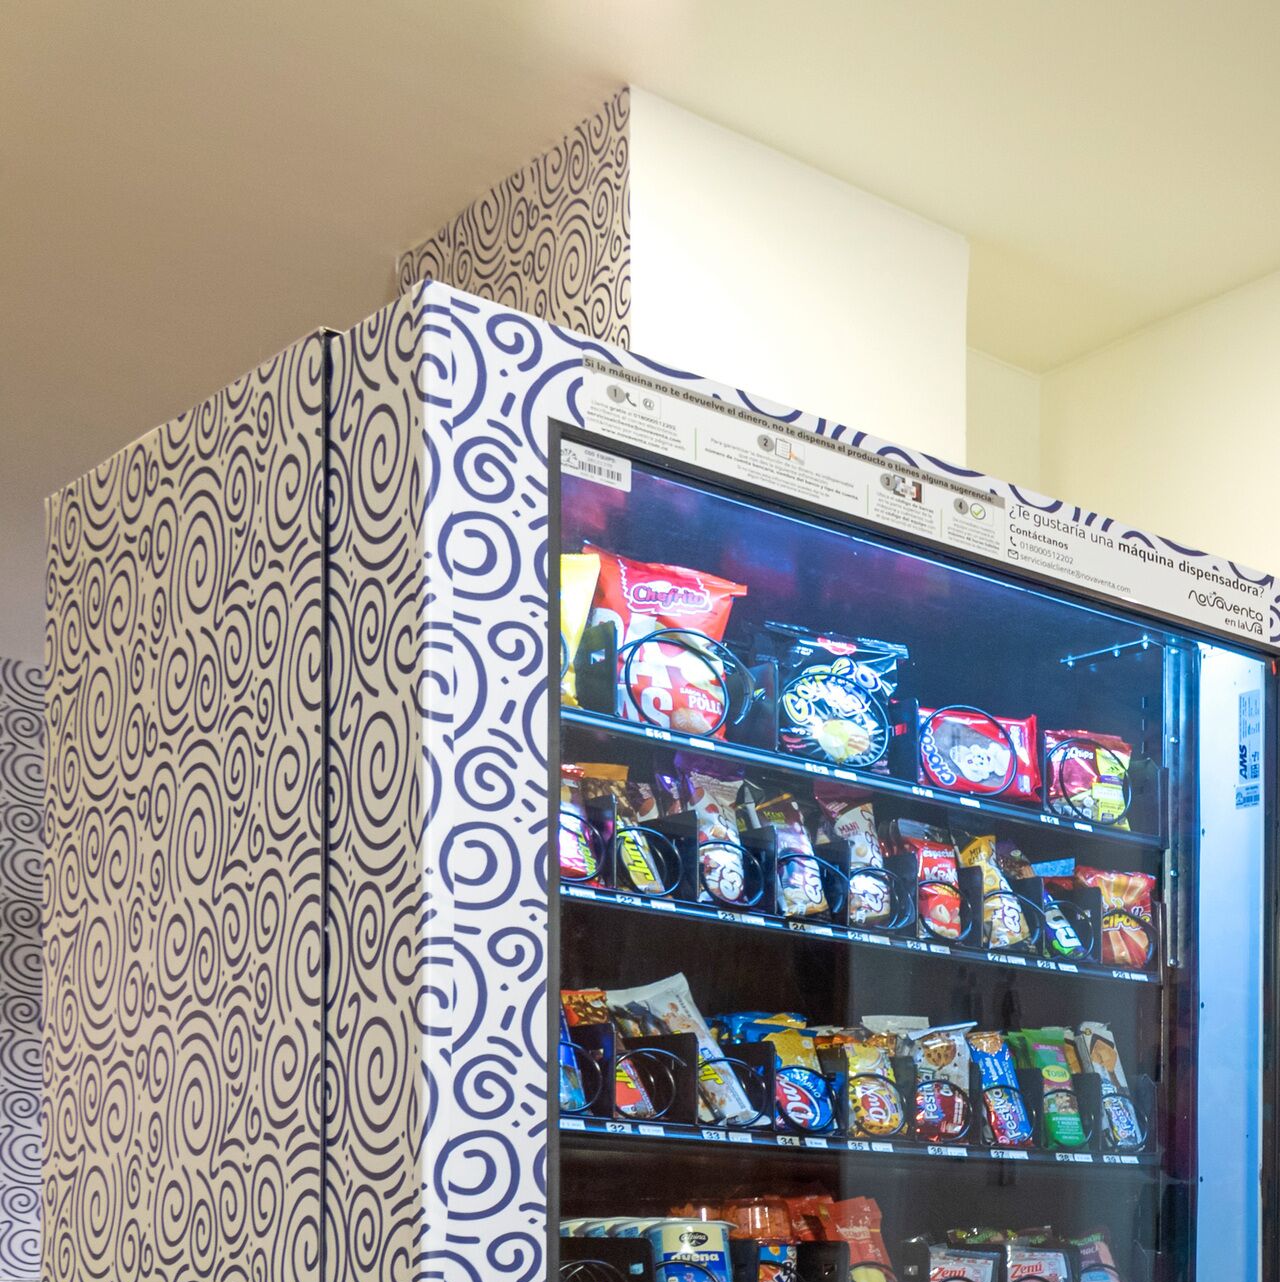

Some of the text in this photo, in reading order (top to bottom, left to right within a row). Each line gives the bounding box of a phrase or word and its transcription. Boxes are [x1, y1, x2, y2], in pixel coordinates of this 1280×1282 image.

[585, 358, 594, 368] Si
[597, 362, 606, 372] la
[609, 367, 653, 388] máquina
[656, 384, 668, 393] no
[670, 387, 680, 397] te
[683, 392, 725, 412] devuelve
[728, 407, 736, 416] el
[738, 411, 770, 429] dinero,
[772, 424, 784, 432] no
[786, 427, 796, 436] te
[798, 430, 835, 450] dispensa
[838, 442, 846, 452] el
[848, 450, 885, 467] producto
[895, 464, 920, 478] tienes
[922, 474, 949, 488] alguna
[1009, 524, 1069, 551] Contáctanos
[1009, 504, 1265, 599] ¿Te gustaría una máquina dispensadora?
[1225, 617, 1236, 626] en
[1240, 744, 1248, 780] AMS
[720, 912, 736, 921] 23
[610, 1124, 625, 1133] 32
[706, 1132, 720, 1140] 33
[780, 1138, 794, 1146] 34
[851, 1142, 864, 1150] 35
